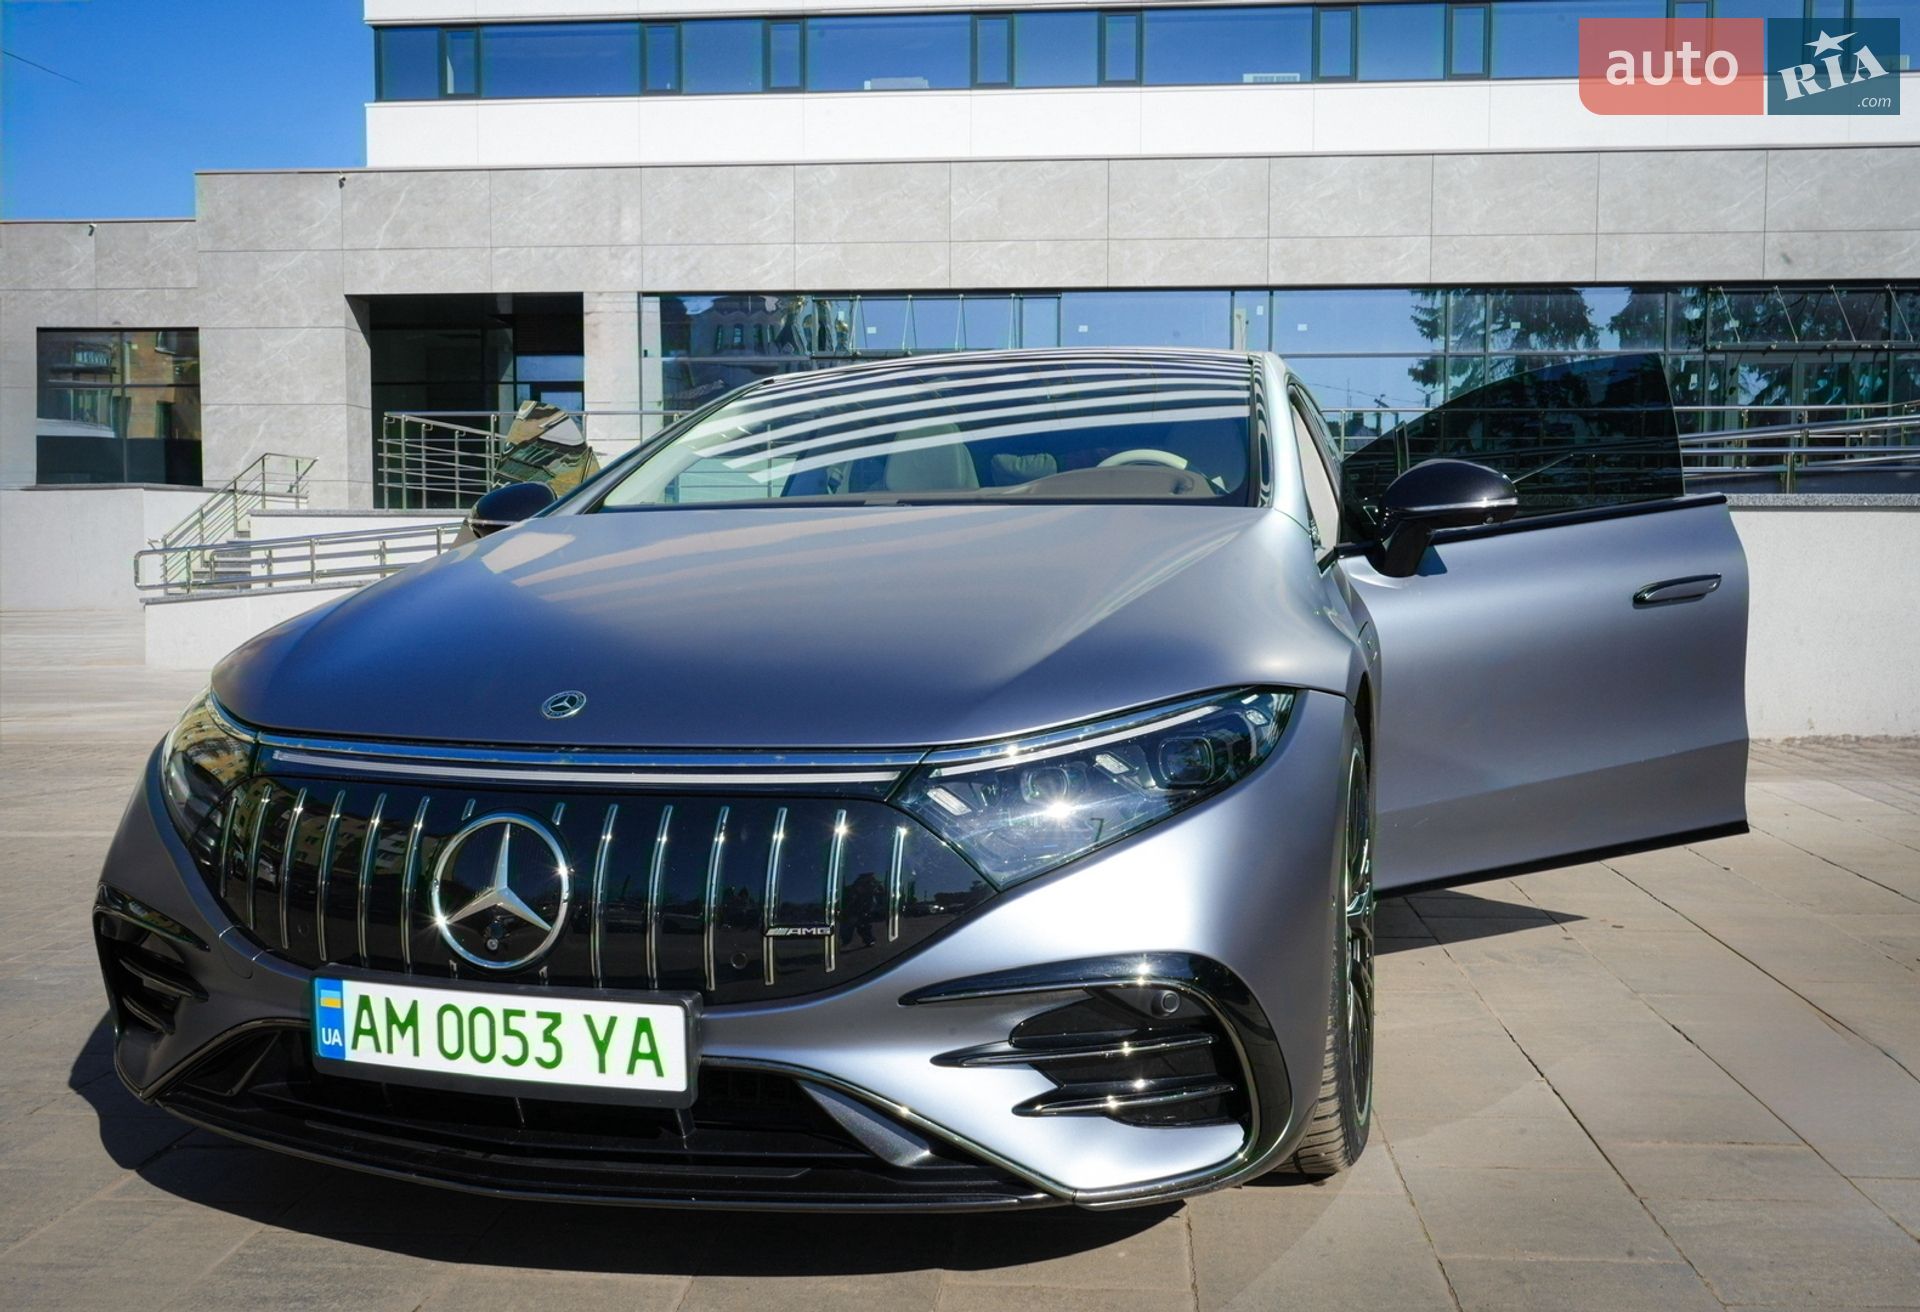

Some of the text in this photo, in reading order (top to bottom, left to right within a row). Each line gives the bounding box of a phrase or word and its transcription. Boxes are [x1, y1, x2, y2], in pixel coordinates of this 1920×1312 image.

[321, 1027, 343, 1048] UA
[351, 994, 665, 1078] AM 0053 YA
